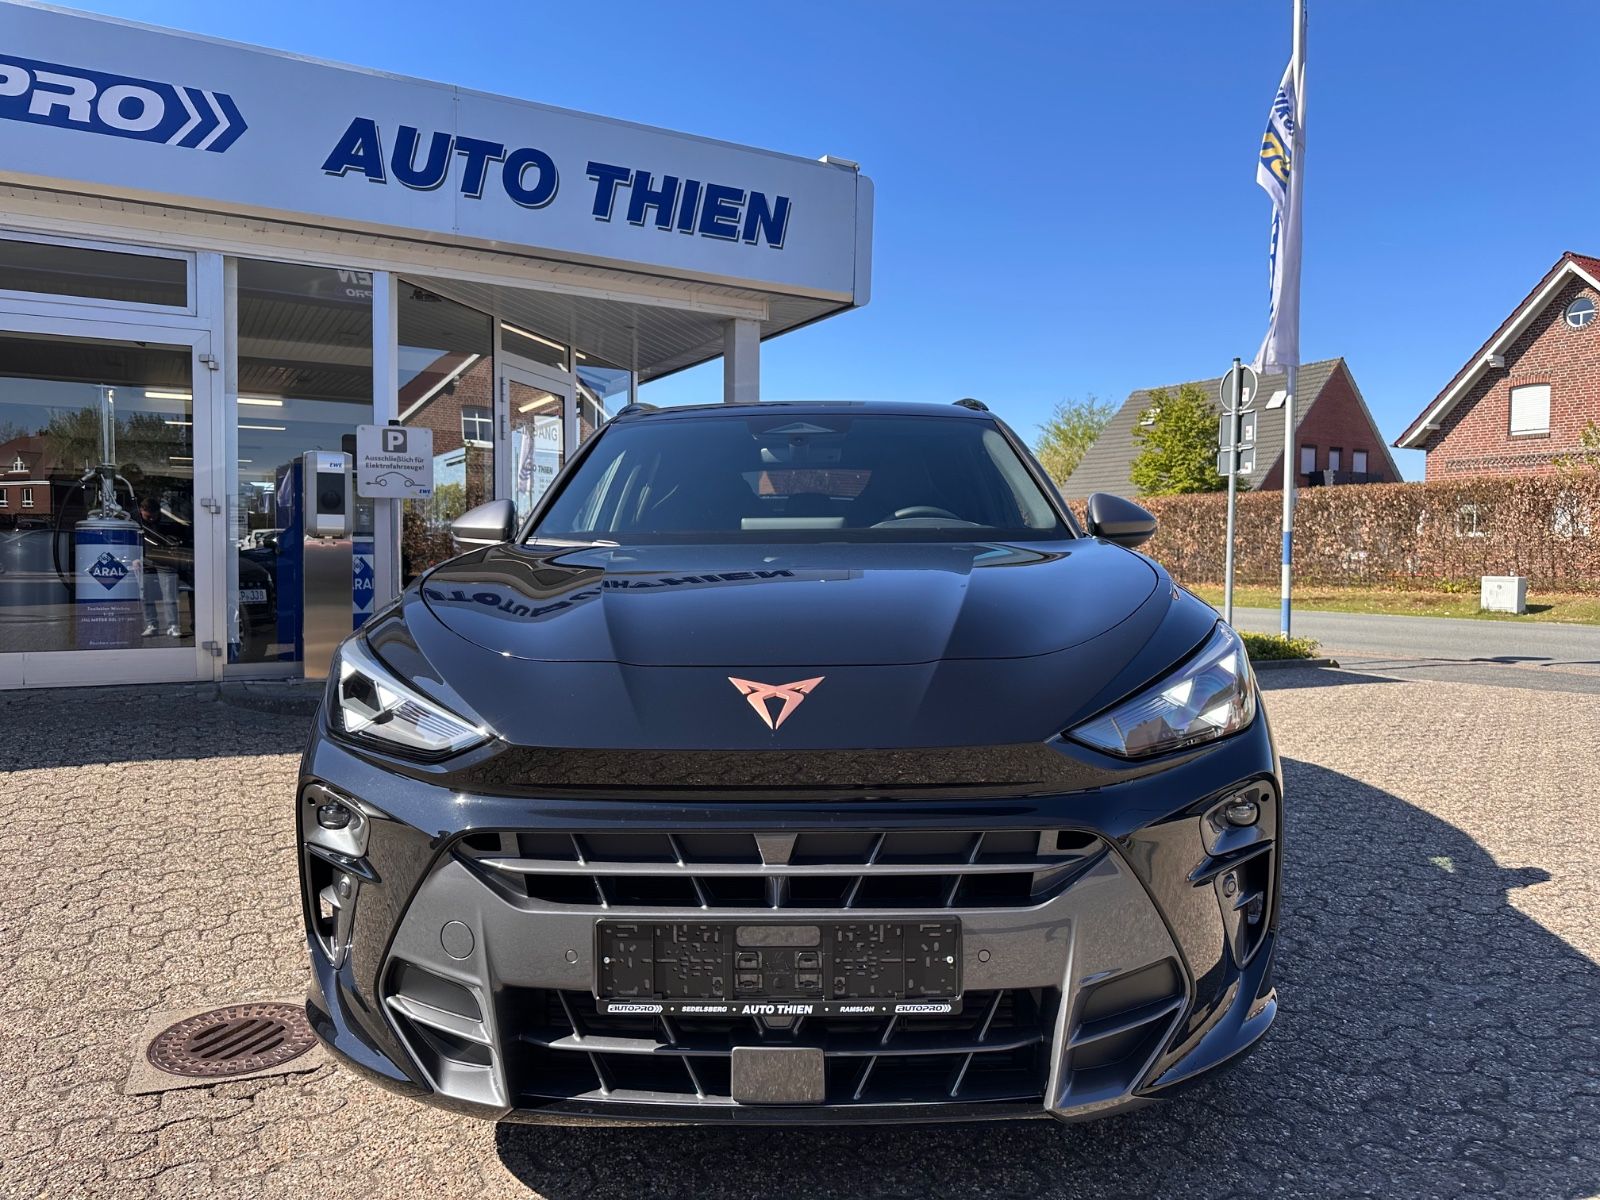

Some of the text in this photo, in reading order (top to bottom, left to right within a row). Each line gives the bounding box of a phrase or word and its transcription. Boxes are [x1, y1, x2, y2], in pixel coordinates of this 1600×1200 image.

[321, 117, 791, 250] AUTO THIEN
[387, 431, 405, 451] P
[365, 455, 413, 463] Ausschließlich
[93, 566, 125, 576] ARAL
[352, 578, 374, 590] RA
[741, 1004, 775, 1014] AUTO
[777, 1004, 813, 1014] THIEN
